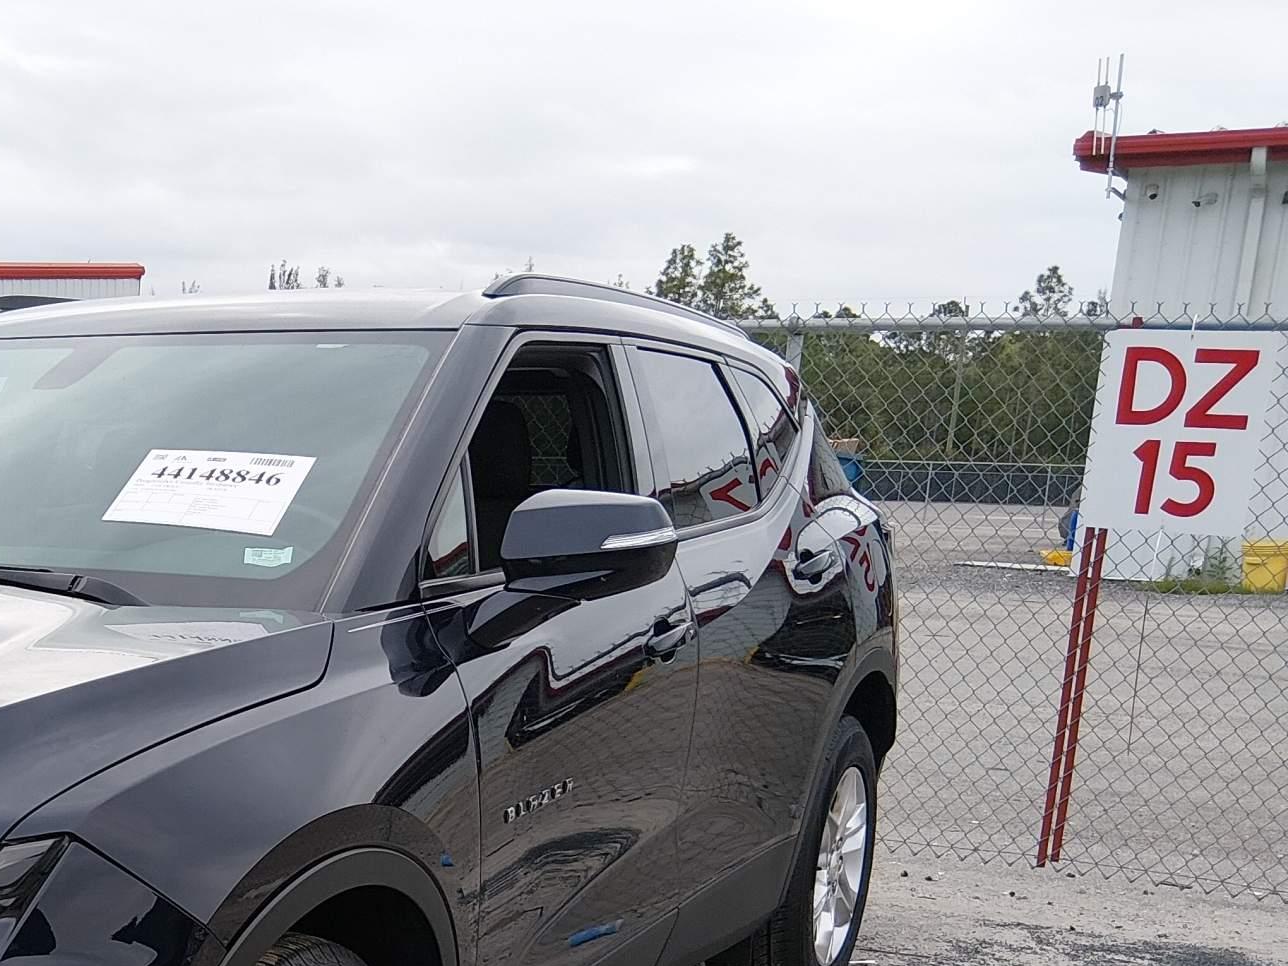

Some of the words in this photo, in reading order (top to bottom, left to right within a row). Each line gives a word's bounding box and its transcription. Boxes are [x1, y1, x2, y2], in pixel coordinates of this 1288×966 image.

[1115, 346, 1261, 430] DZ
[151, 465, 286, 487] 44148846
[1133, 439, 1217, 517] 15
[503, 776, 574, 824] BLAZER
